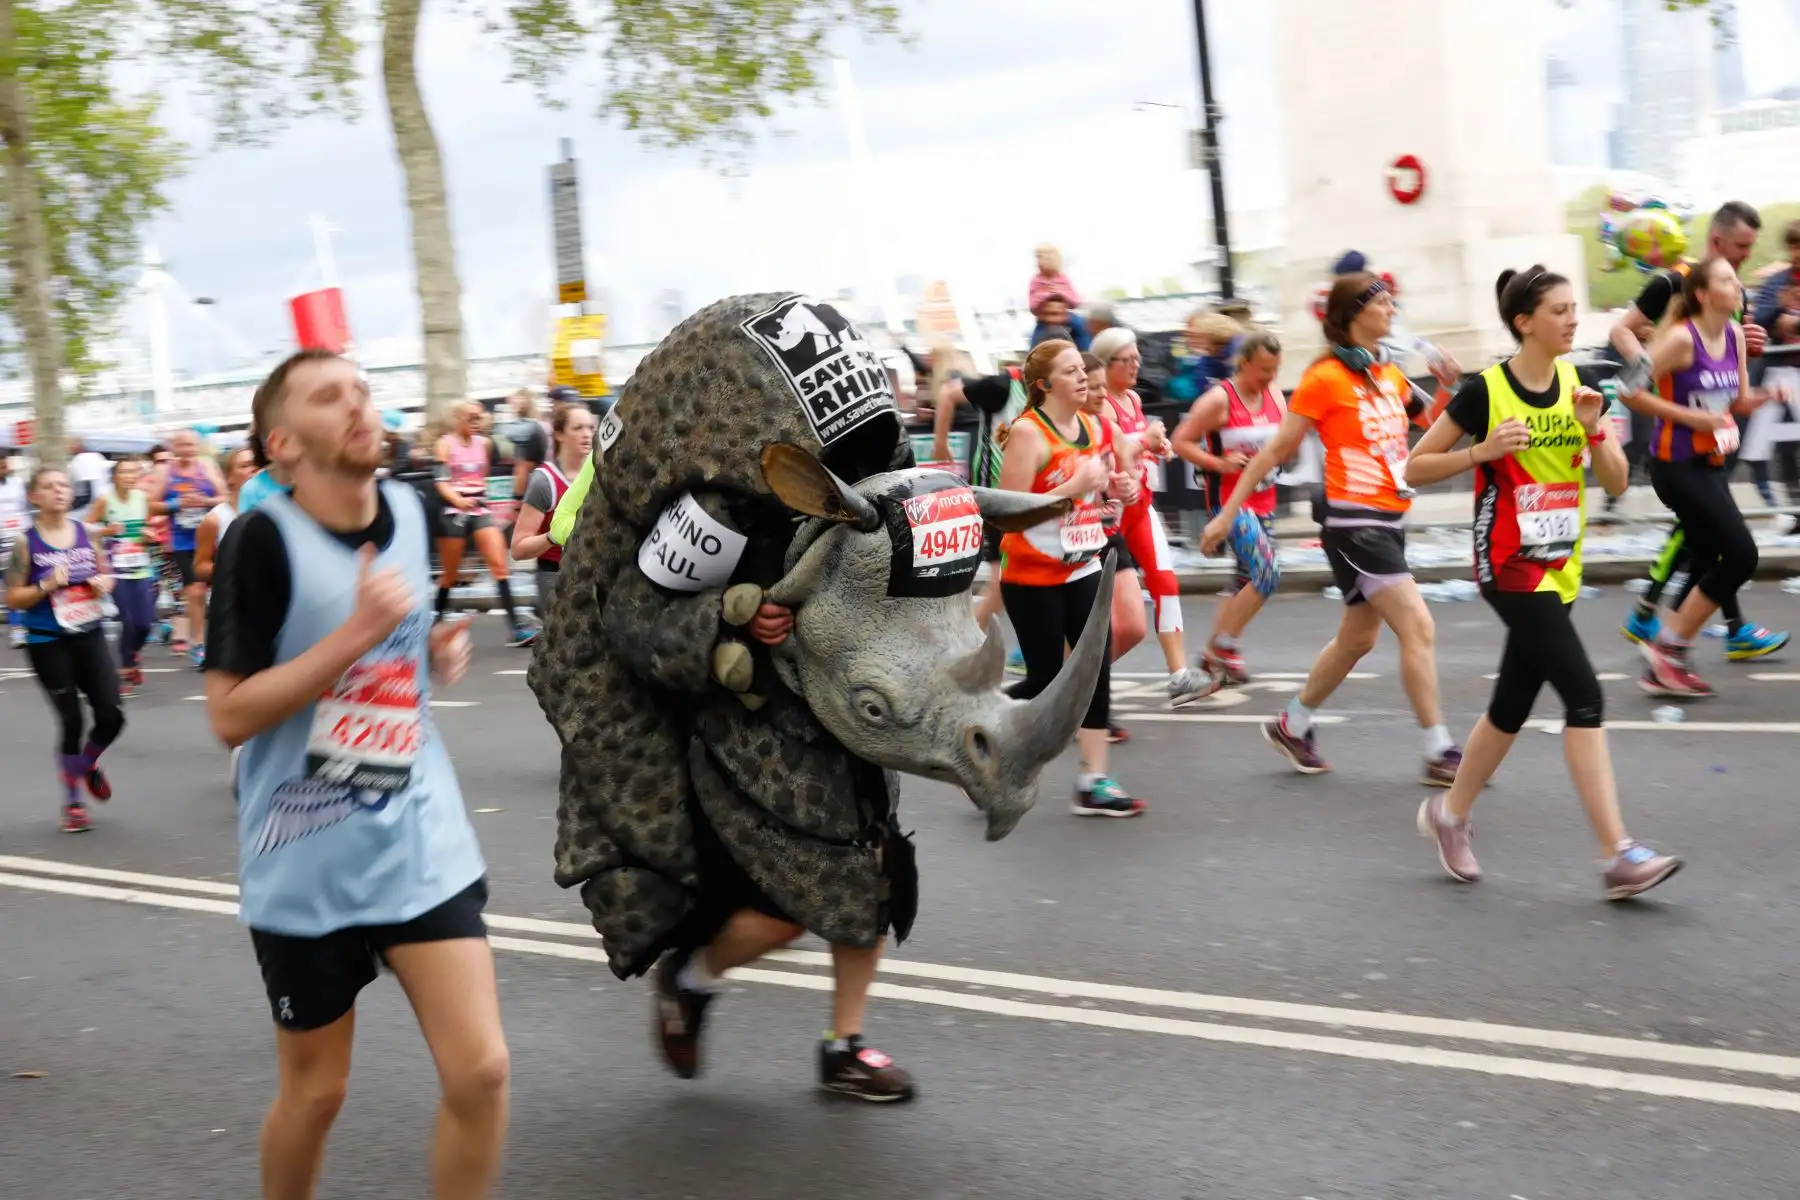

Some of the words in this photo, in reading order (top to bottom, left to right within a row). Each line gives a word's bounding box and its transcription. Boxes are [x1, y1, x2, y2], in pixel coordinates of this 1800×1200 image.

[800, 355, 855, 396] SAVE
[808, 368, 888, 421] RHIN
[1525, 414, 1574, 432] AURA
[940, 493, 975, 508] money
[665, 500, 722, 556] RHINO
[921, 522, 982, 559] 49478
[651, 529, 702, 581] PAUL
